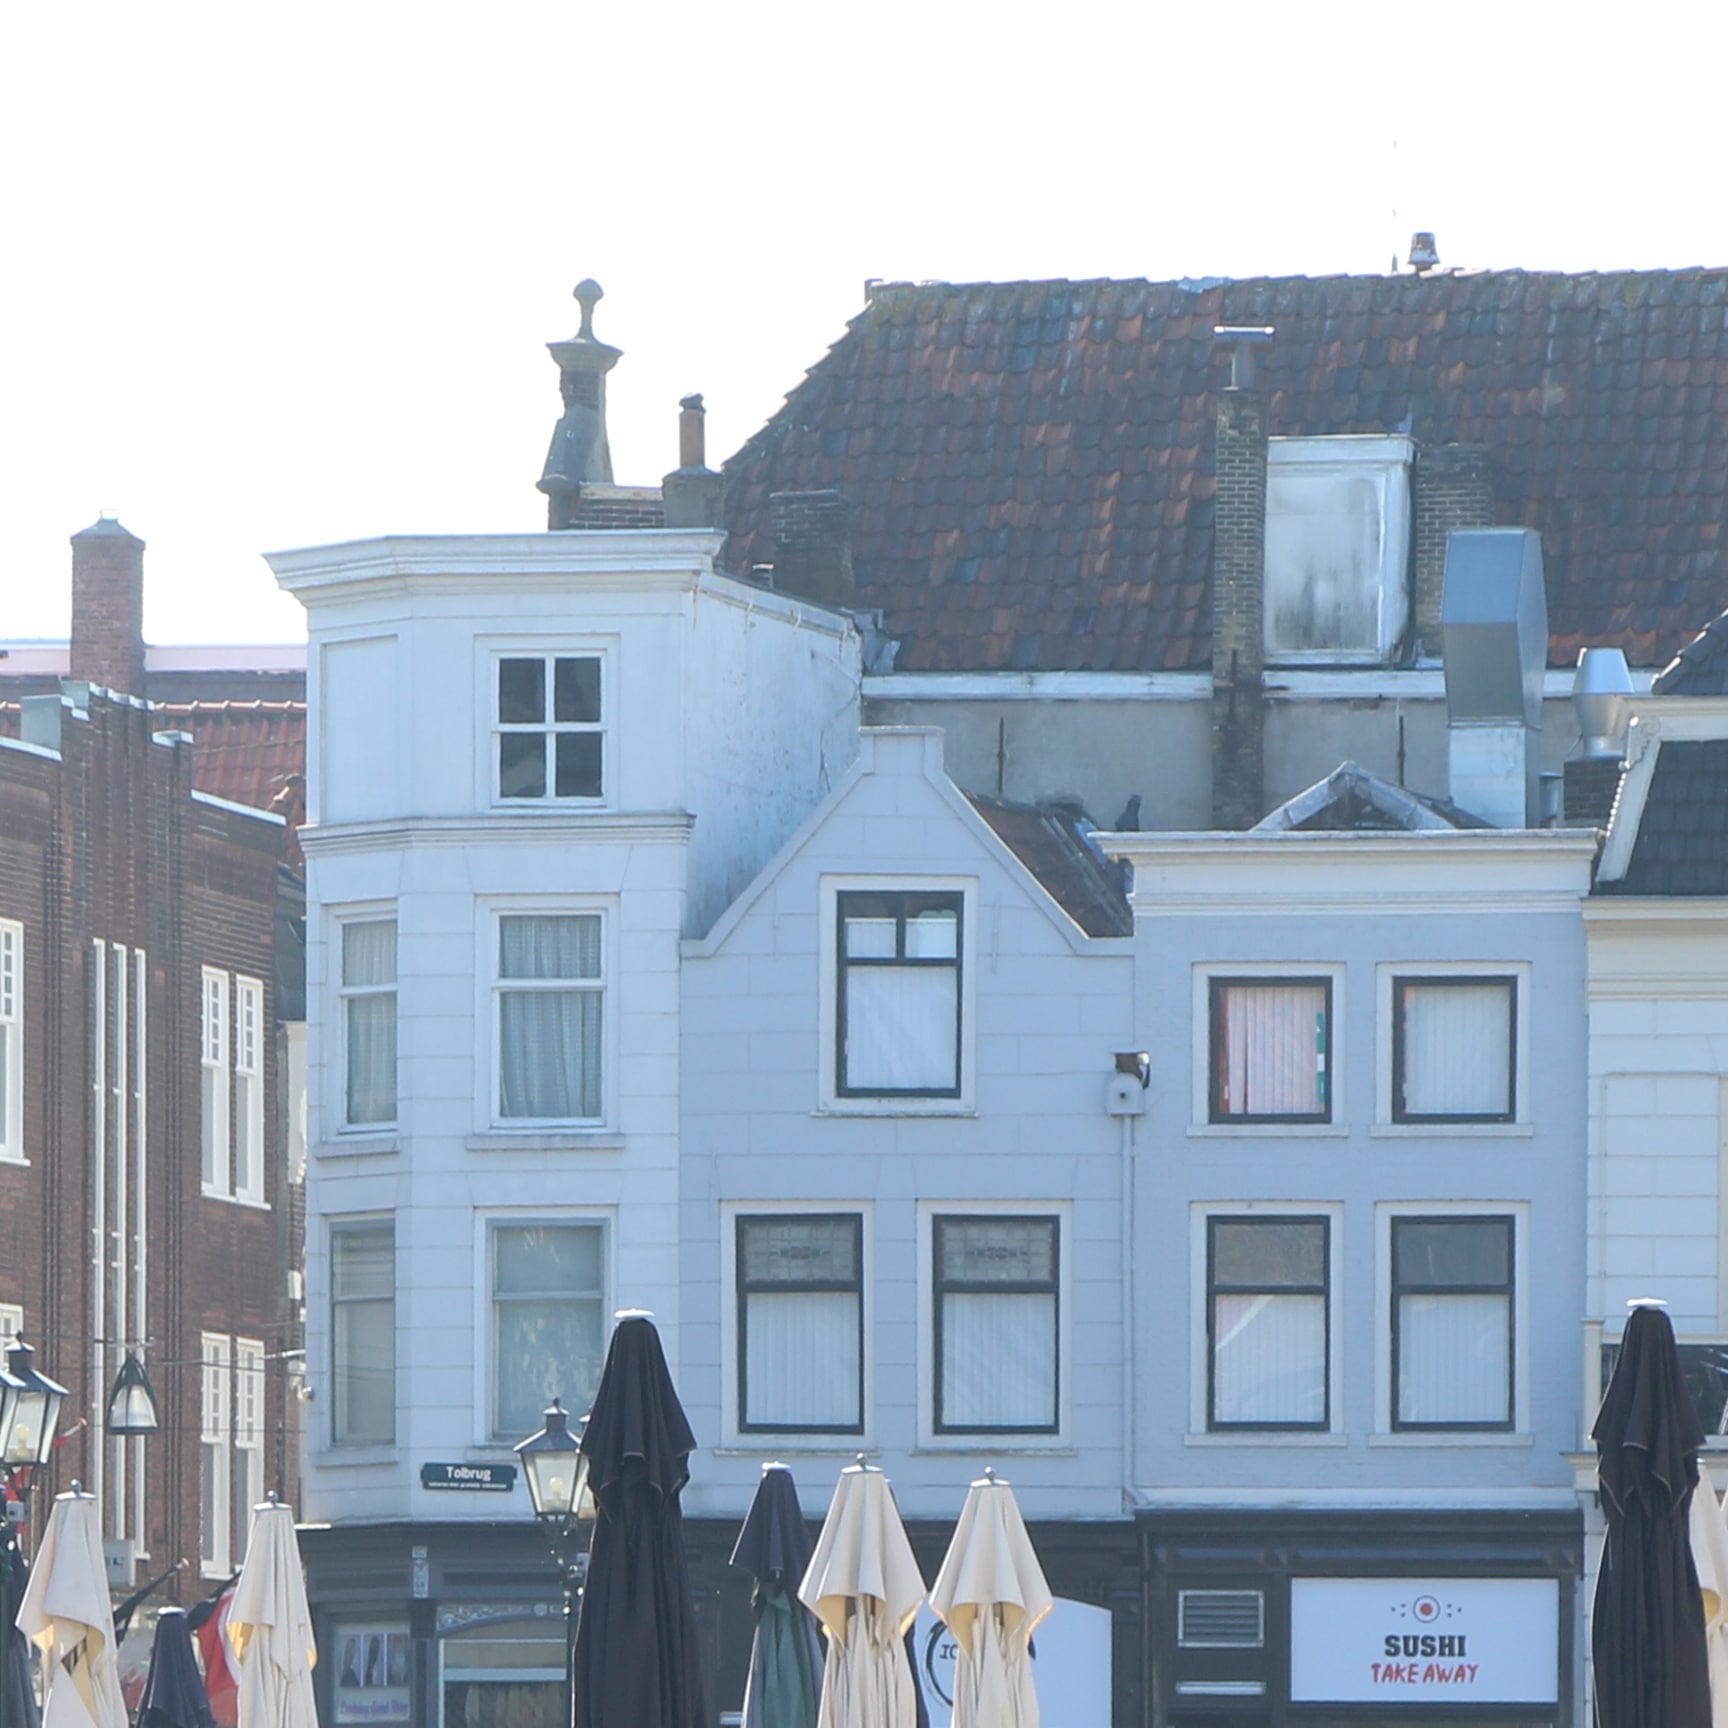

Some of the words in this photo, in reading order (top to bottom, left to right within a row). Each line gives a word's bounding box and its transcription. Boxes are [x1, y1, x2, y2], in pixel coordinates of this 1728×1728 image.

[446, 1466, 492, 1481] Tolbrug
[1384, 1634, 1467, 1658] SUSHI
[1370, 1662, 1420, 1684] TAKE
[1422, 1662, 1479, 1684] AWAY
